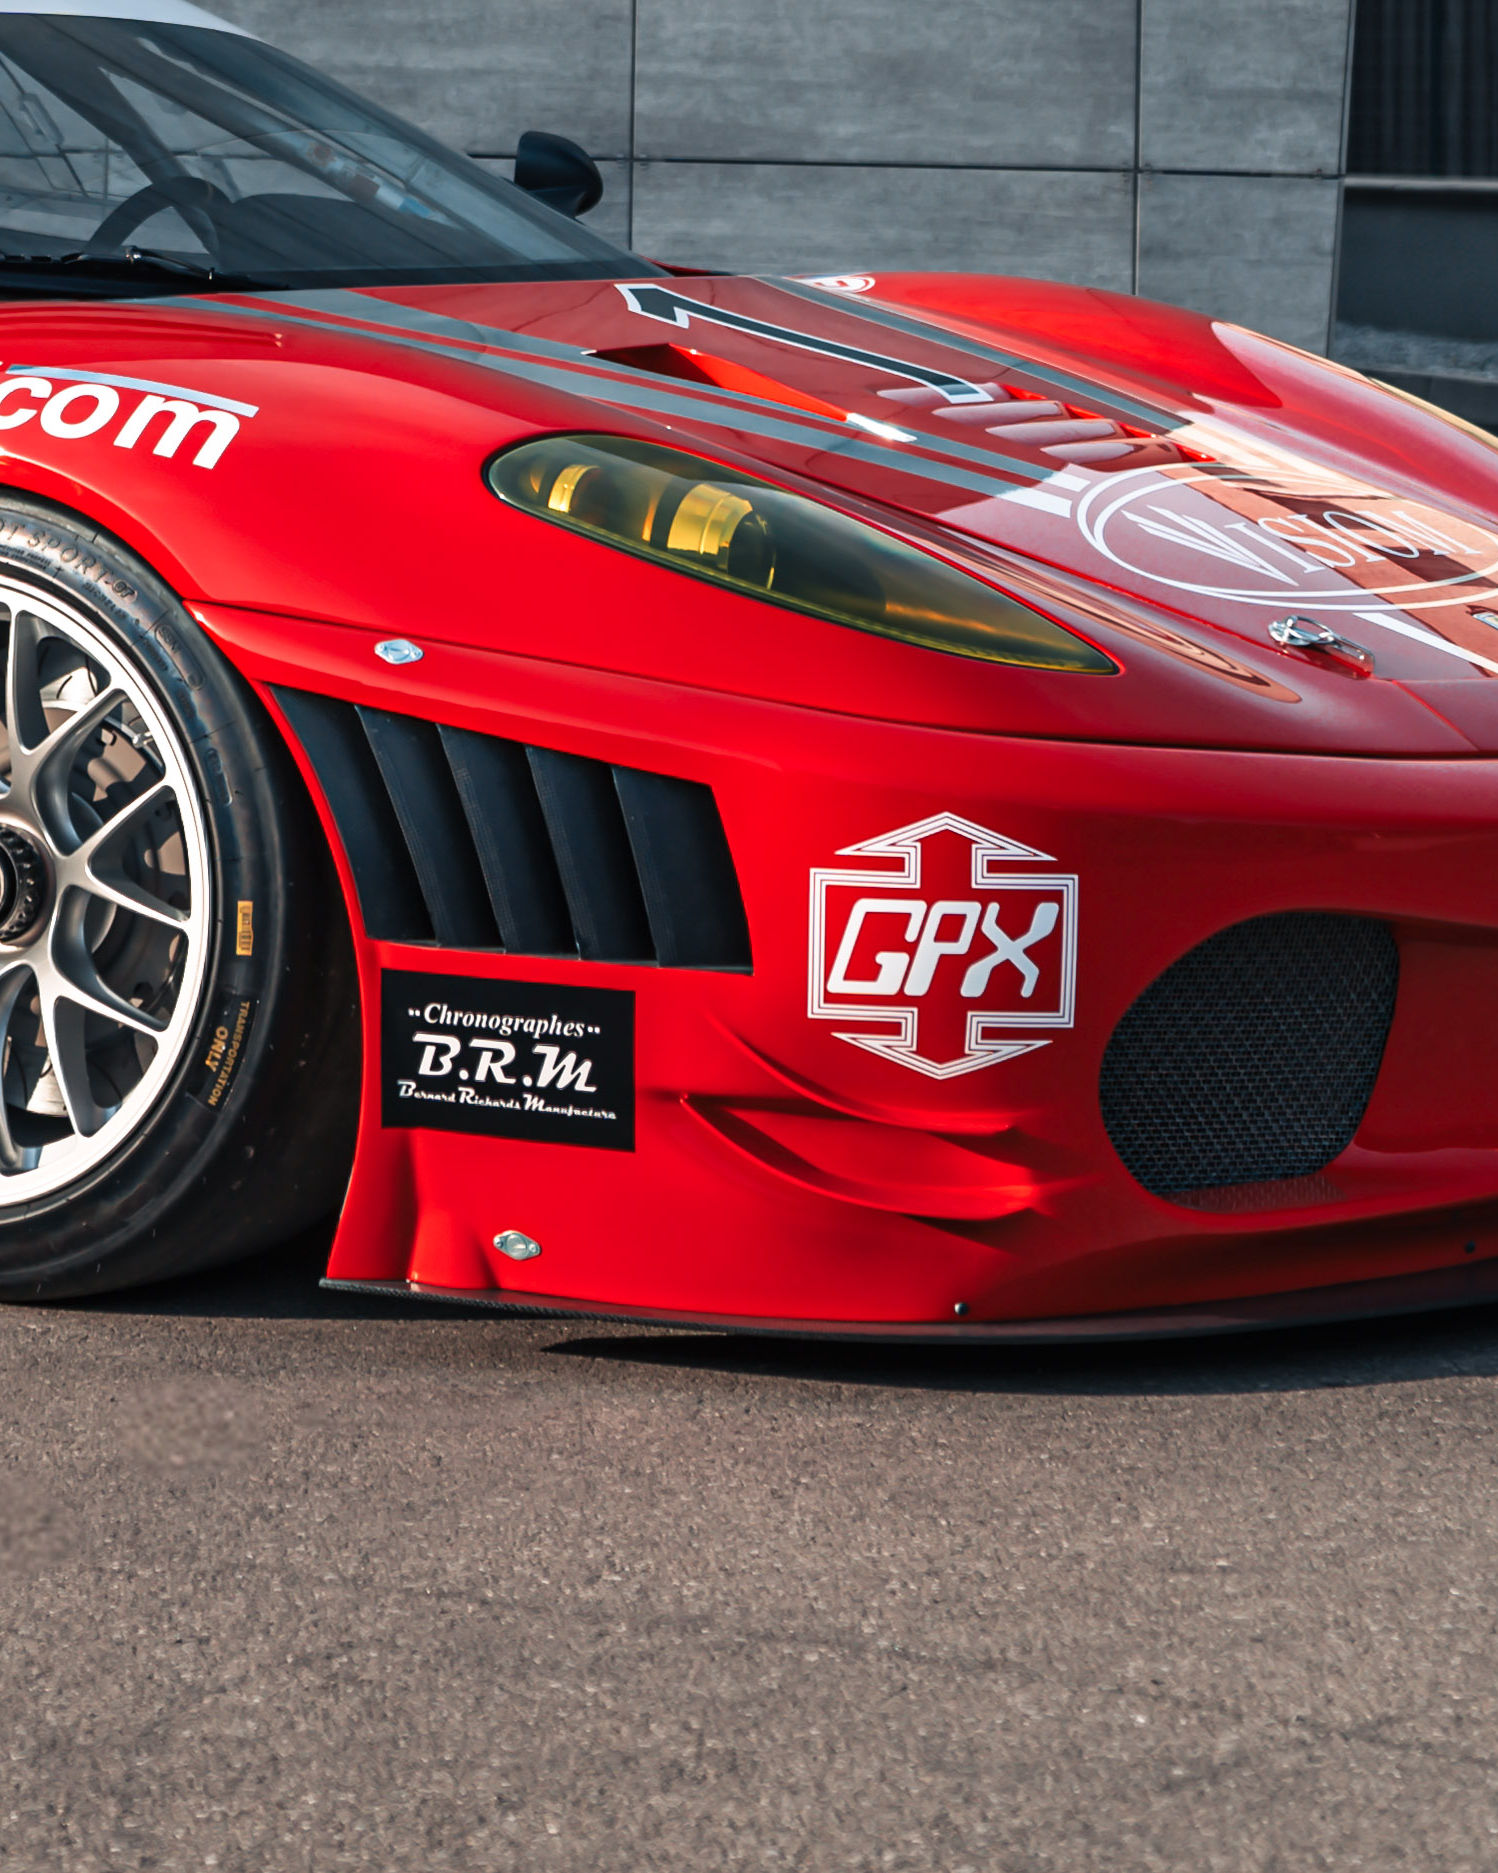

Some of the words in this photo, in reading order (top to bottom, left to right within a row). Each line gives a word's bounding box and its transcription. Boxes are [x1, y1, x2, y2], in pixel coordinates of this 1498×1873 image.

[613, 283, 994, 405] 1
[1121, 504, 1482, 587] VISIOM
[826, 897, 1059, 998] GPX
[205, 1025, 229, 1073] ONLY
[207, 1000, 251, 1107] TRANSPORTATION
